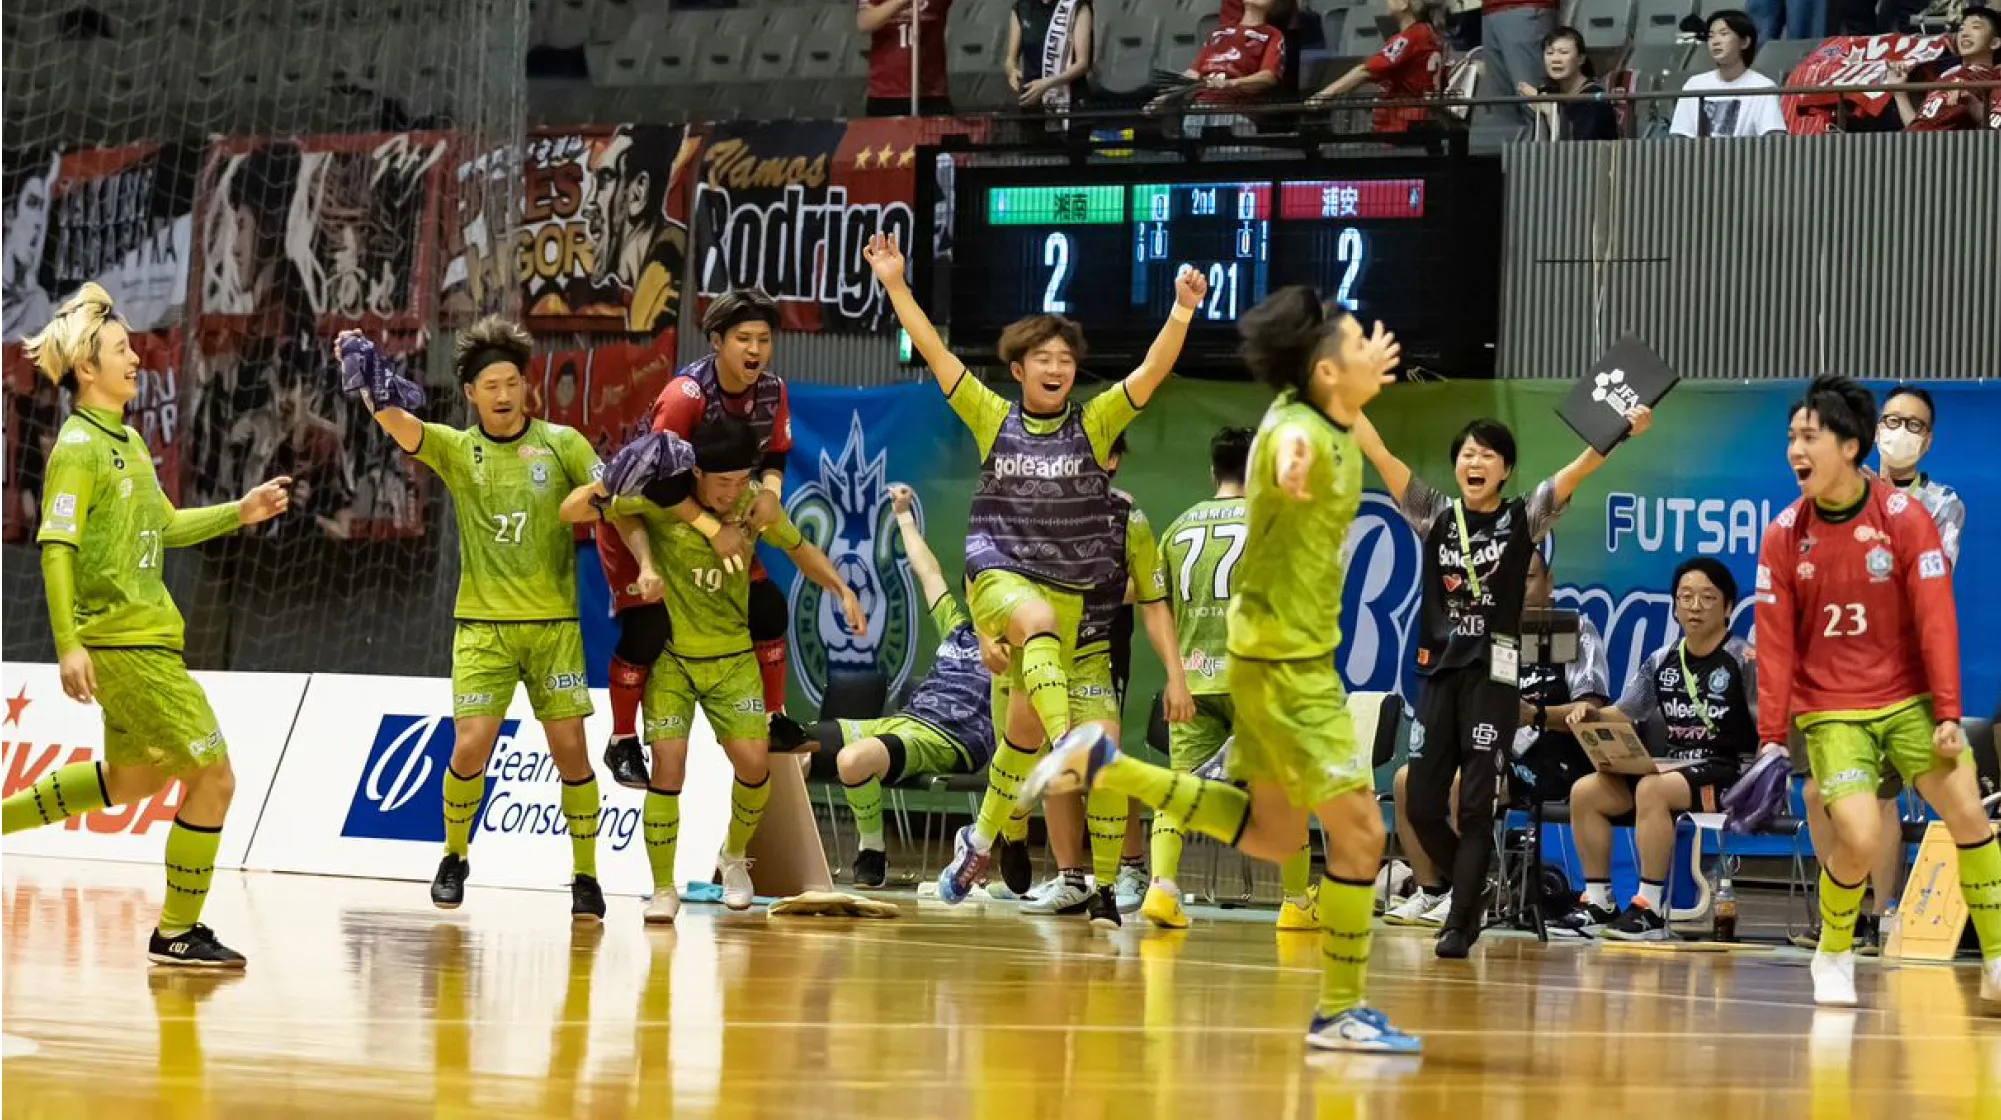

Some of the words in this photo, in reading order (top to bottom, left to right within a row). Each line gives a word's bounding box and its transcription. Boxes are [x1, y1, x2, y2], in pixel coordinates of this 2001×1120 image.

[704, 137, 828, 190] Vamos
[1053, 192, 1089, 221] 湘南
[1192, 188, 1216, 215] 2nd
[1321, 186, 1359, 217] 浦安
[693, 182, 914, 318] Rodrigo
[1043, 231, 1069, 313] 2
[1336, 226, 1363, 311] 2
[995, 453, 1083, 480] goleador
[493, 510, 527, 544] 27
[692, 568, 722, 592] 19
[1173, 523, 1247, 602] 77
[1823, 603, 1868, 638] 23
[483, 791, 643, 851] Consuing
